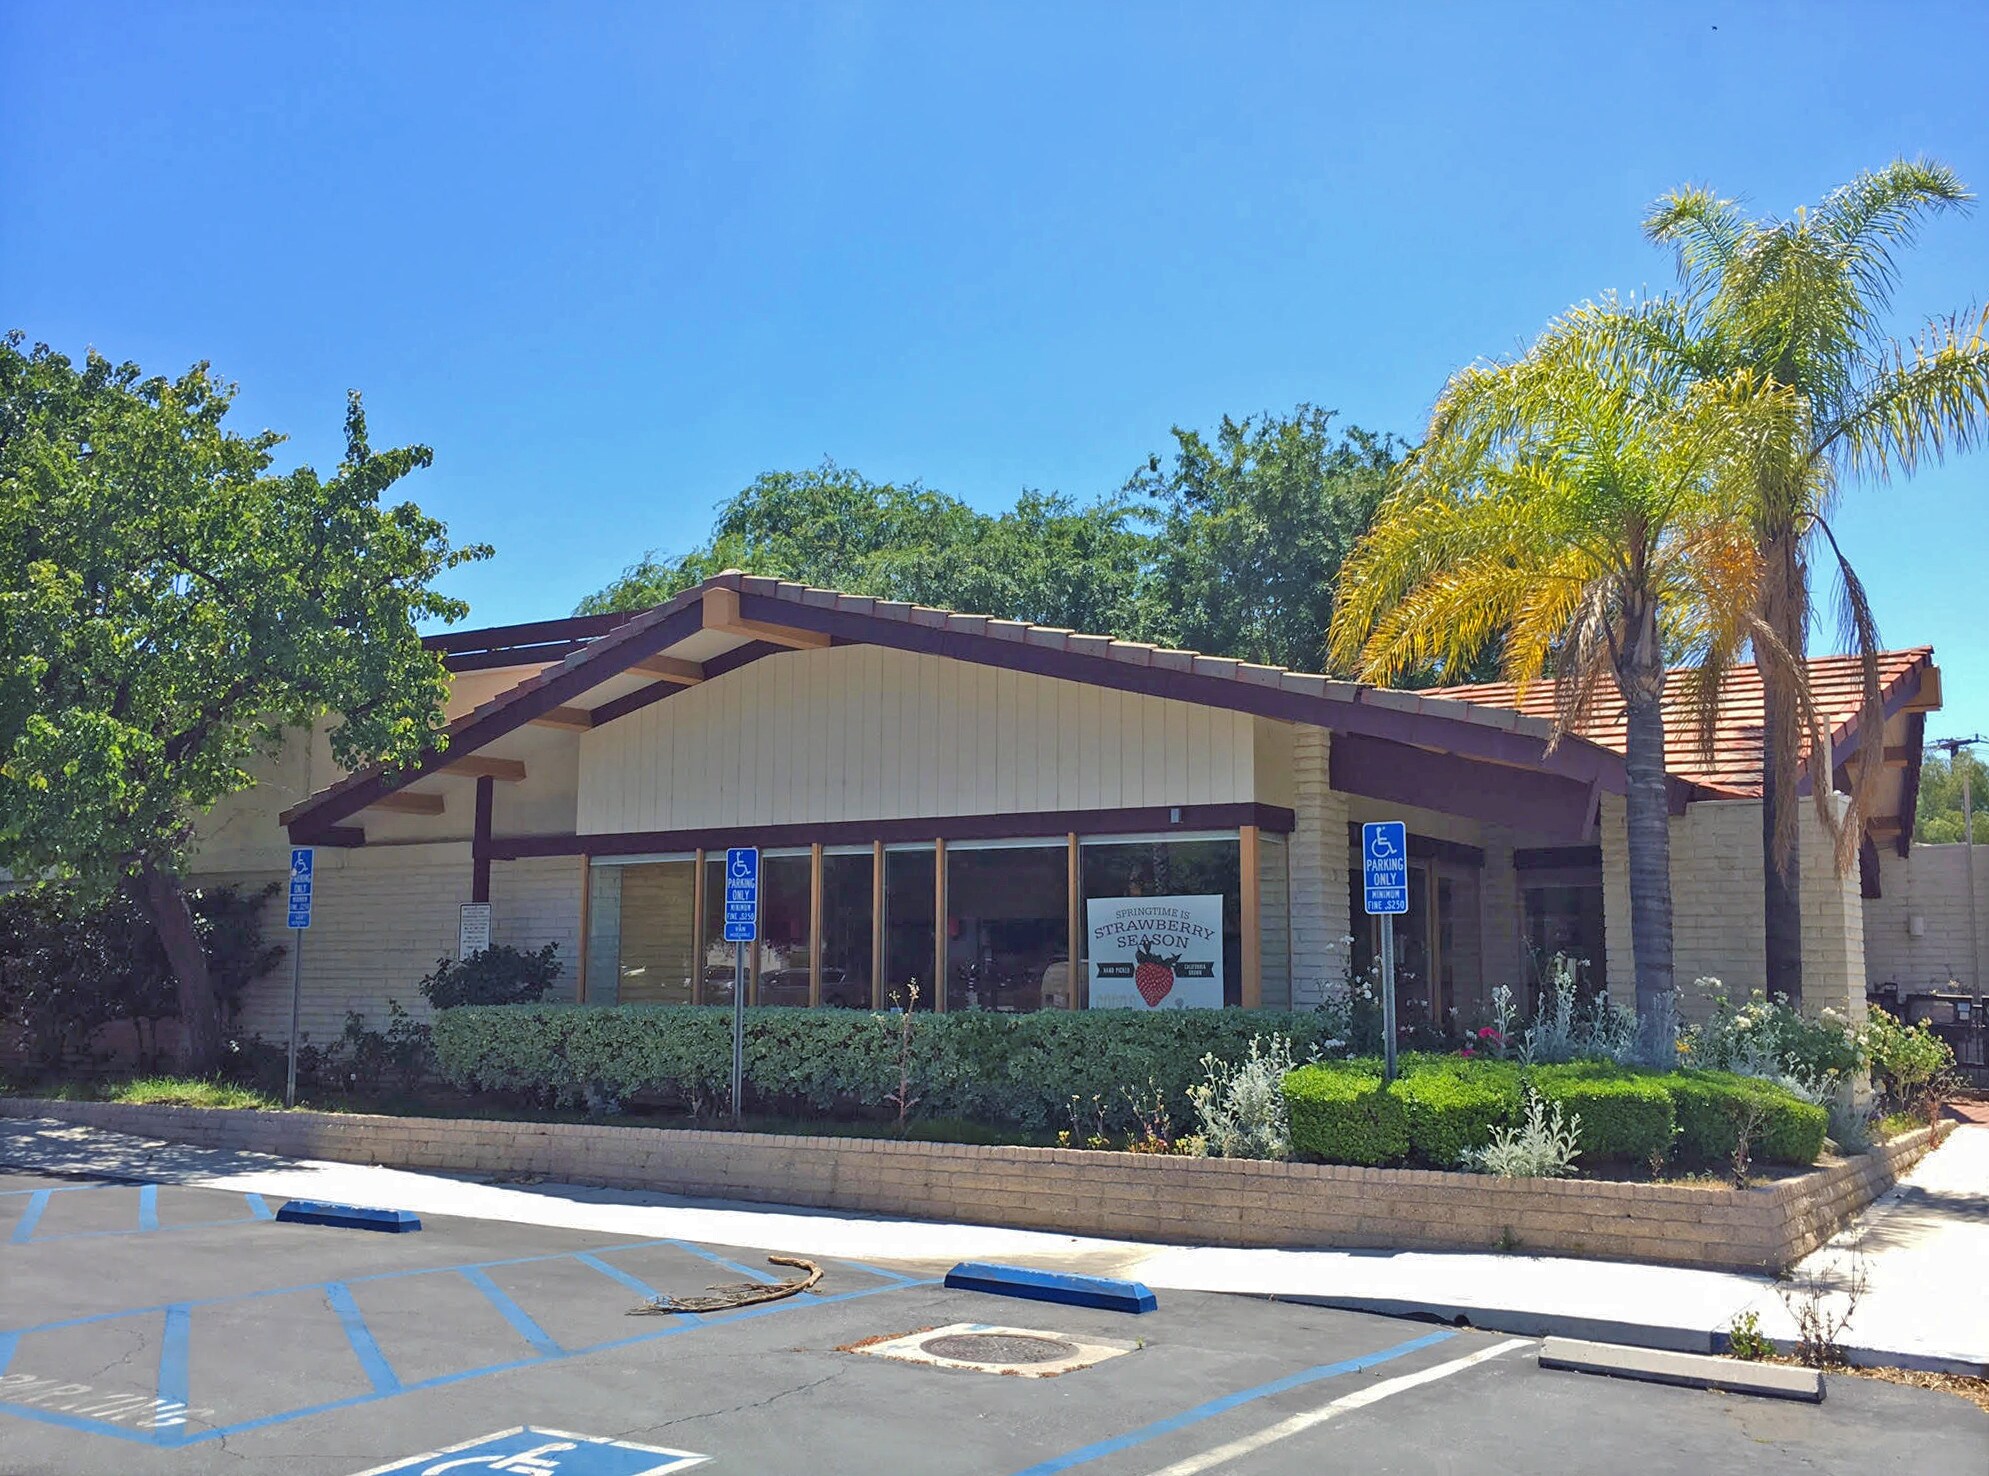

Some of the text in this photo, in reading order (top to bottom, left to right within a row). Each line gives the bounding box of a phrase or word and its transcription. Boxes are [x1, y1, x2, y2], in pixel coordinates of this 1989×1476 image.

[1366, 857, 1404, 872] PARKING
[728, 877, 755, 889] PARKING
[1373, 872, 1397, 886] ONLY
[732, 889, 750, 901] ONLY
[1371, 889, 1400, 899] MINIMUM
[1367, 900, 1382, 910] FINE
[1115, 906, 1191, 920] SPRINGTIME IS
[1094, 919, 1216, 941] STRAWBERRY
[1117, 933, 1189, 949] SEASON
